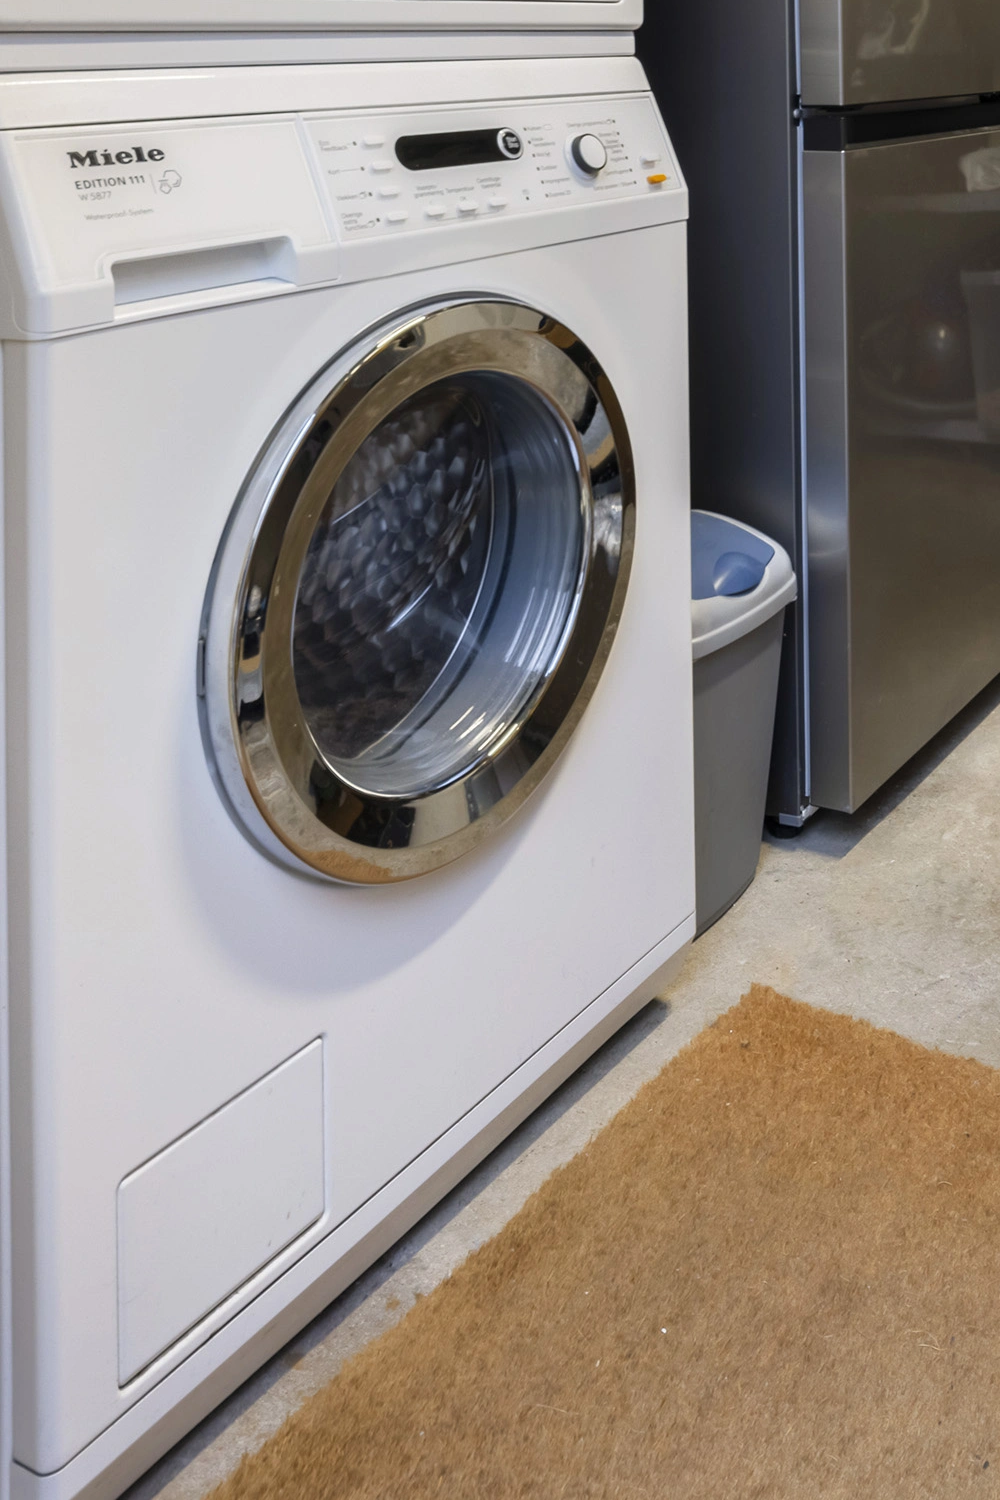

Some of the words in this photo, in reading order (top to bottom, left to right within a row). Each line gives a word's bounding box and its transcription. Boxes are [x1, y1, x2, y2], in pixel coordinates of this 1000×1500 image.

[66, 146, 165, 168] Miele
[75, 176, 127, 190] EDITION
[129, 174, 146, 185] 111
[90, 190, 112, 201] 5877
